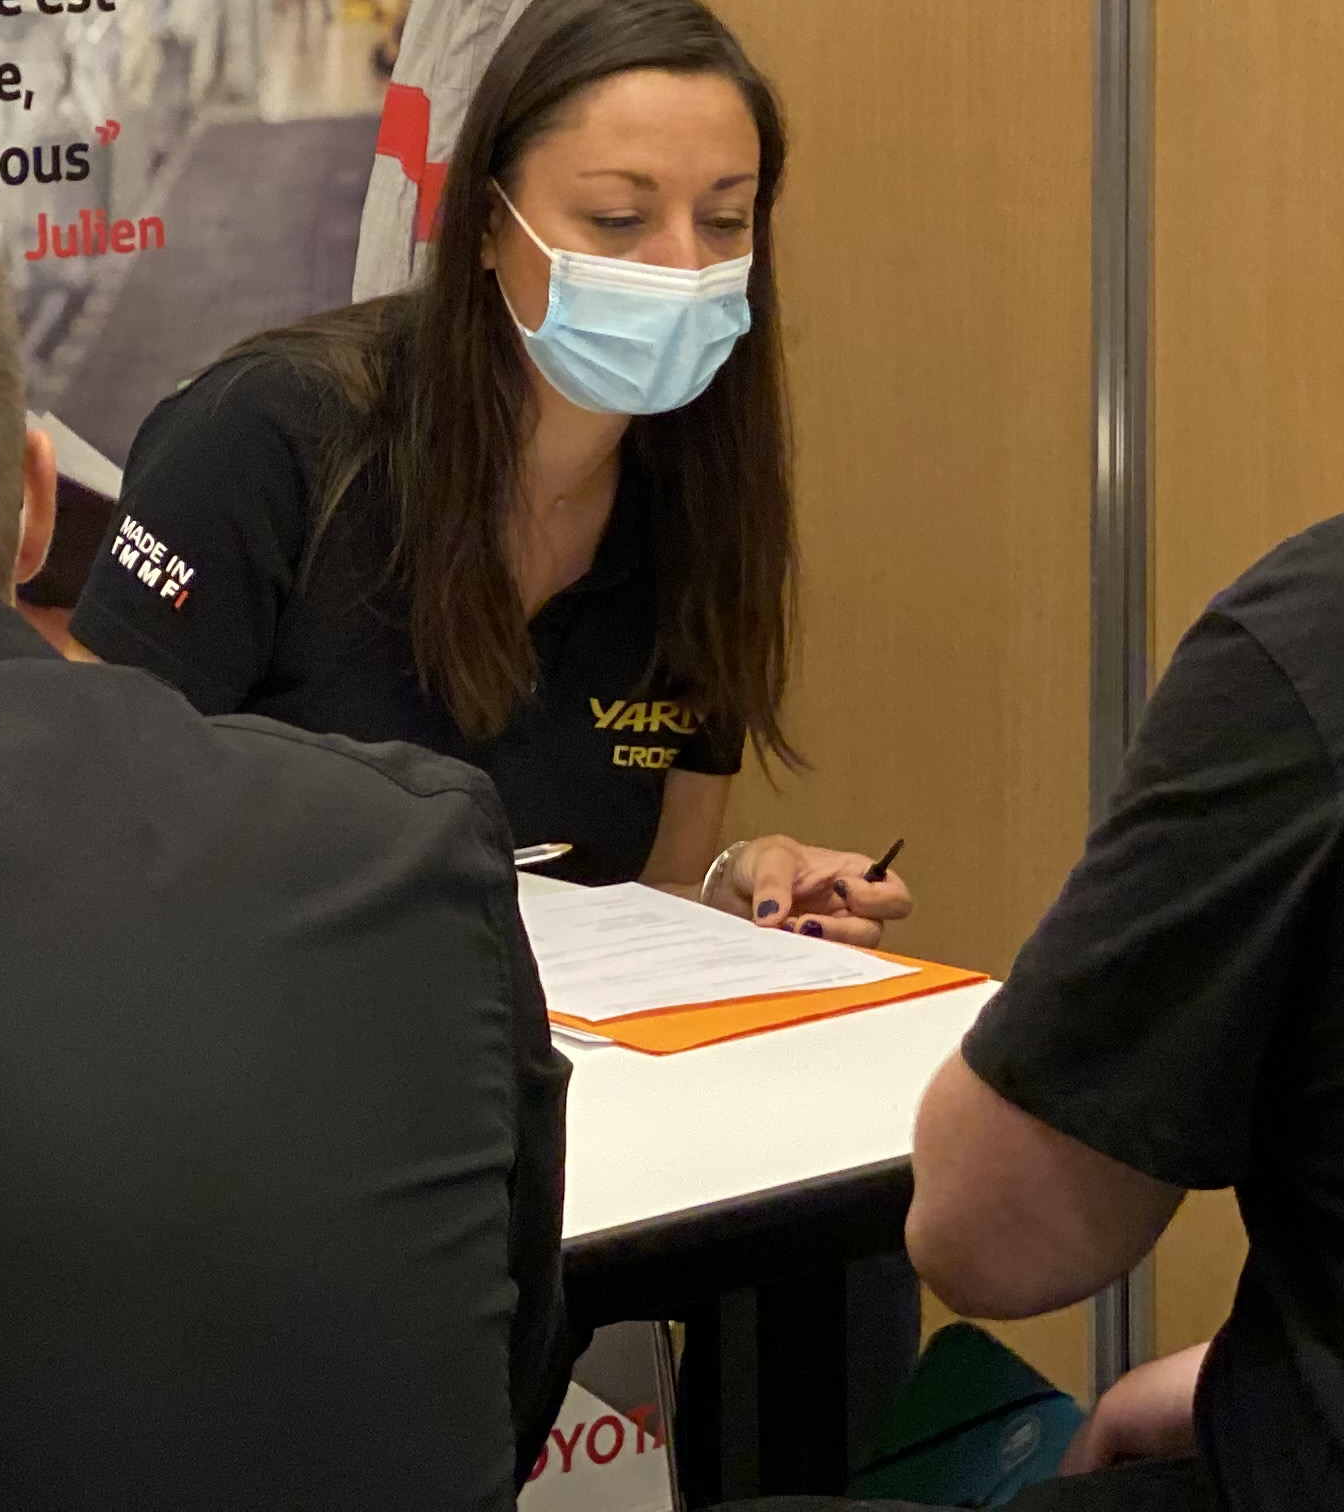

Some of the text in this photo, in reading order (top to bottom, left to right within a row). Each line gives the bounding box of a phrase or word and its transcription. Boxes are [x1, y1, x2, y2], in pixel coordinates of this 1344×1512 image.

[24, 210, 165, 261] Julien
[119, 515, 195, 586] MADE IN
